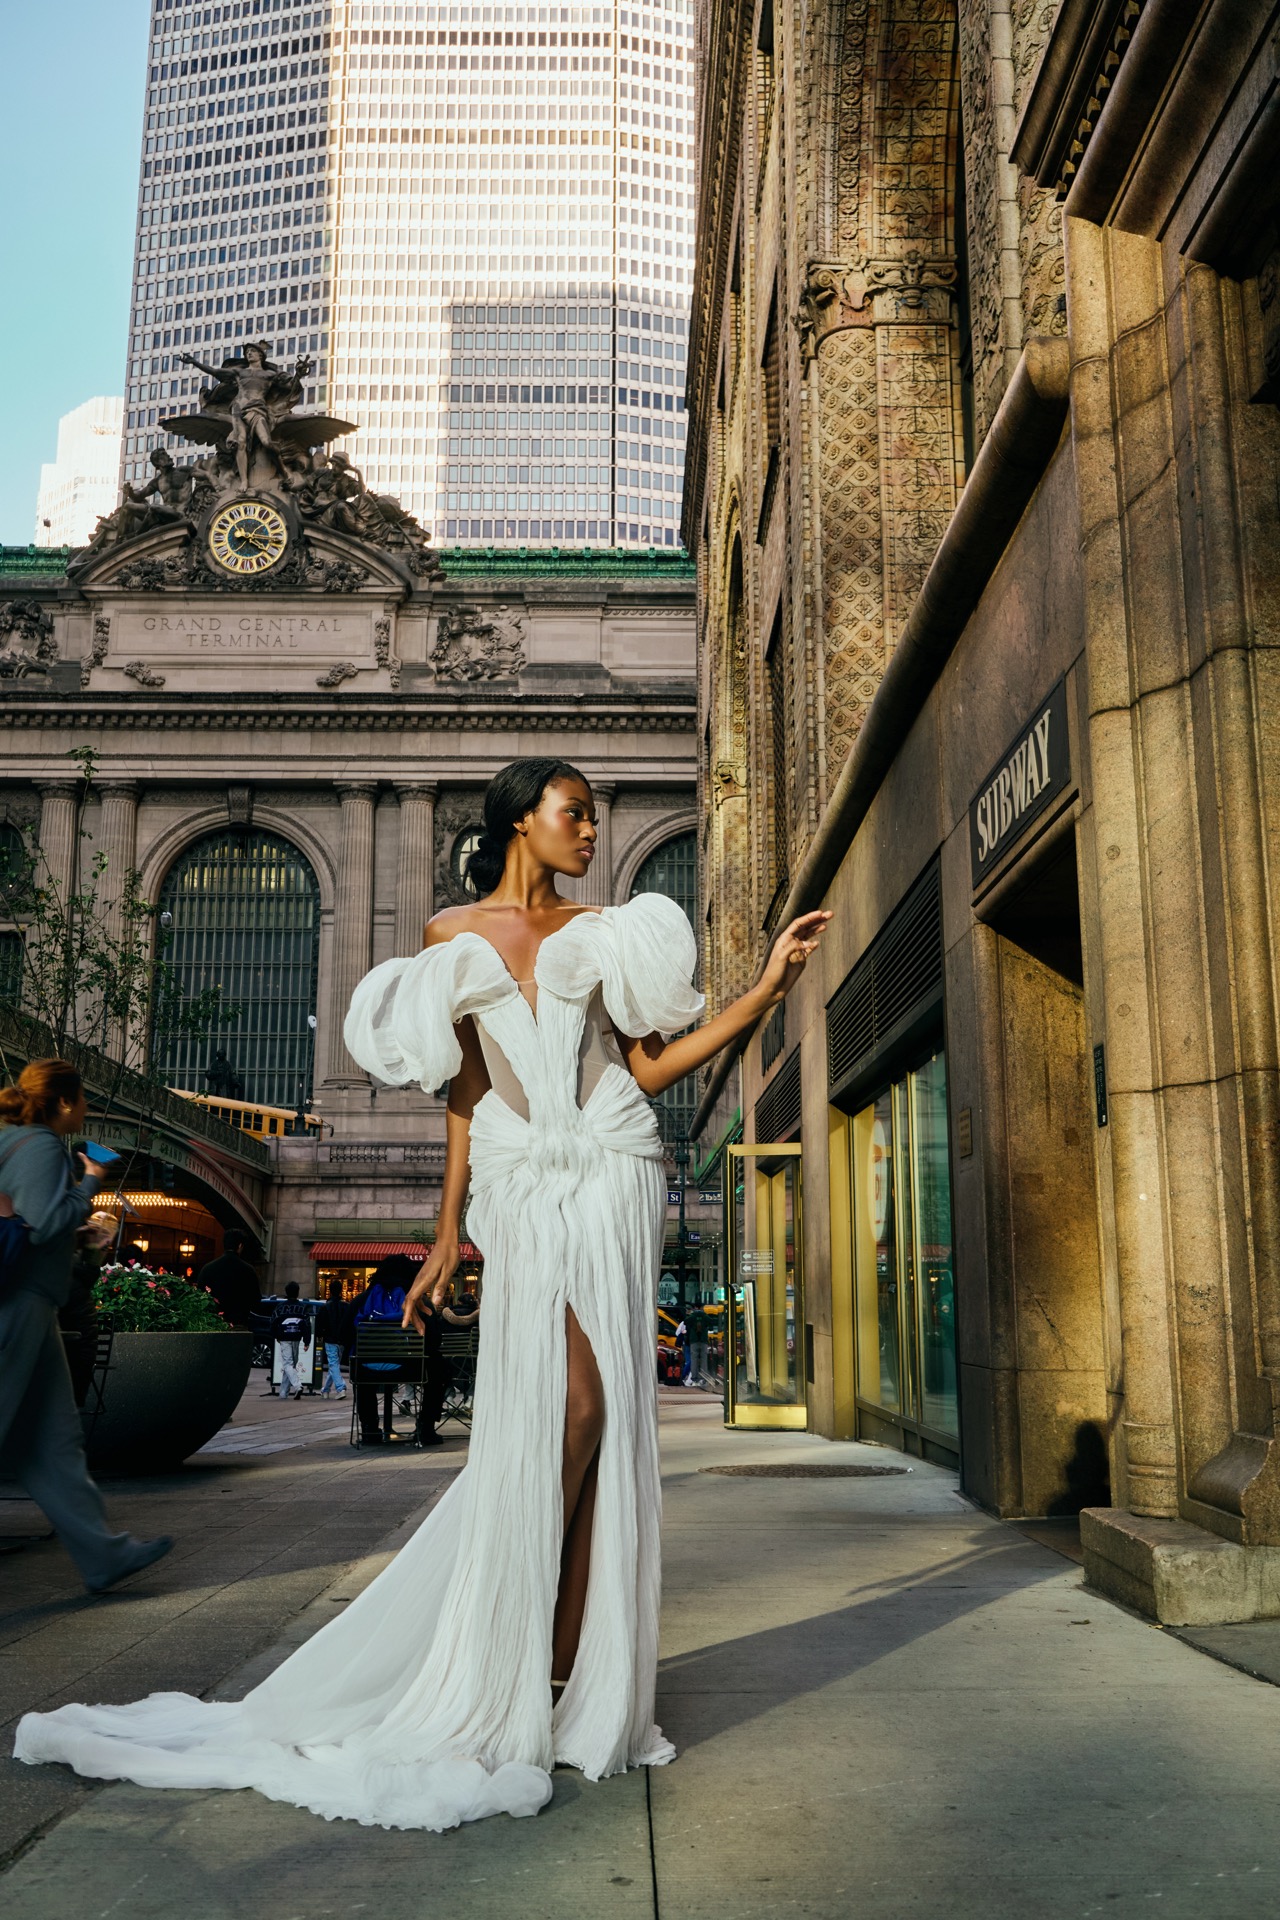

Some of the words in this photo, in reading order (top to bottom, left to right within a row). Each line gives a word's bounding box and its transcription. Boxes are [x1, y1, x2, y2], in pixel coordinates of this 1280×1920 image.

[143, 617, 221, 631] GRAND
[238, 618, 342, 632] CENTRAL
[186, 633, 298, 648] TERMINAL
[977, 709, 1051, 863] SUBWAY
[160, 1143, 182, 1162] GRAND
